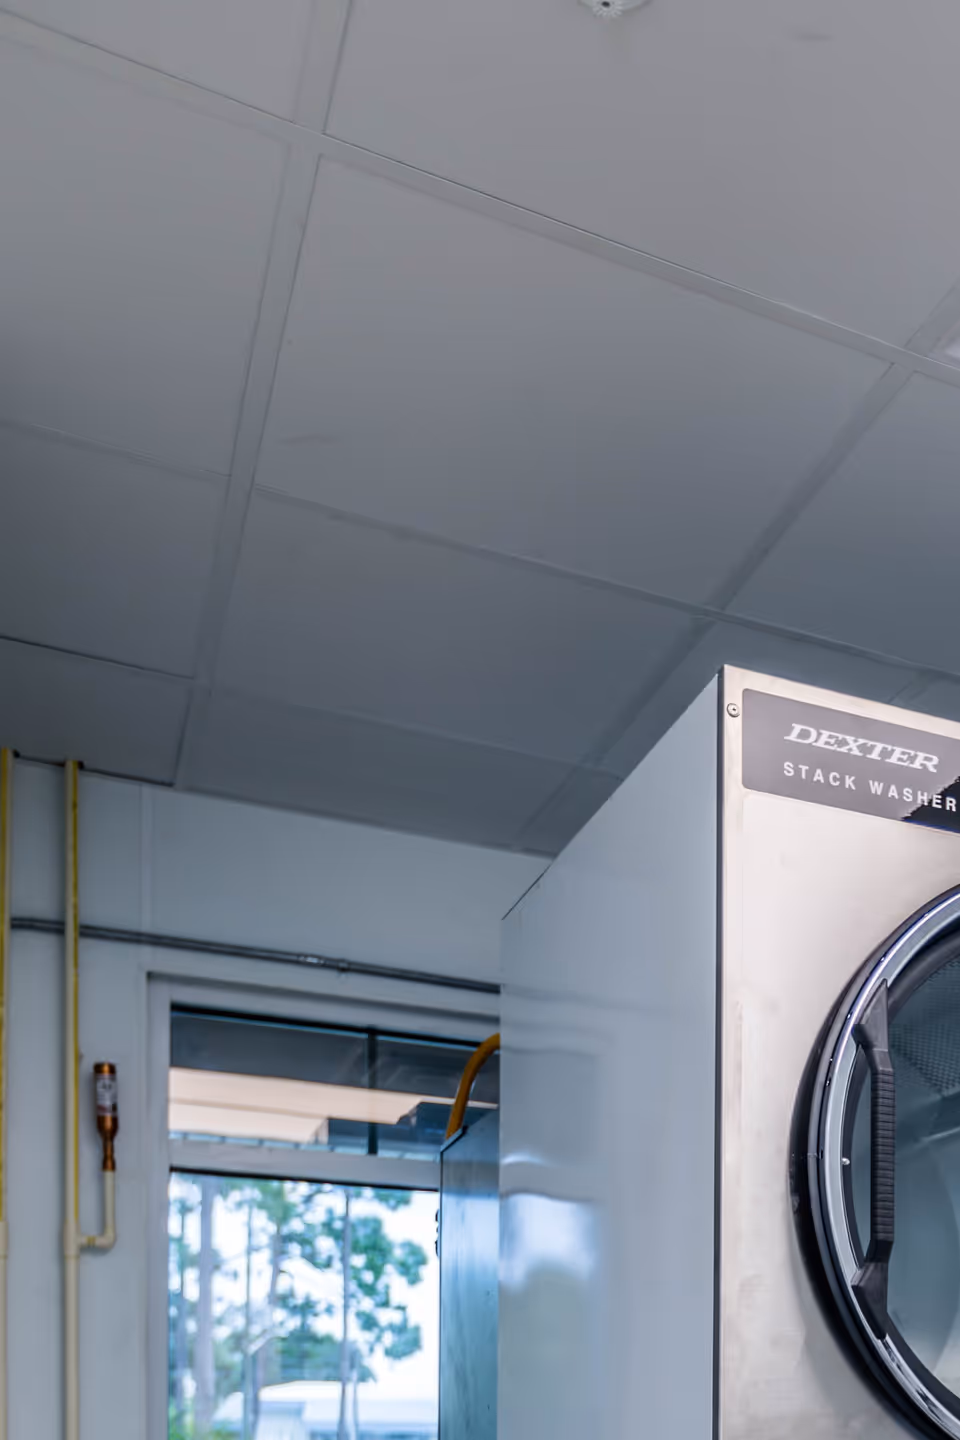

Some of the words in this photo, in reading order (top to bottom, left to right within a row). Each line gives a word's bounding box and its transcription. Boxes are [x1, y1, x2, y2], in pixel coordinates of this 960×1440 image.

[784, 723, 939, 772] DEXTER
[784, 761, 856, 791] STACK
[869, 779, 957, 812] WASHER
